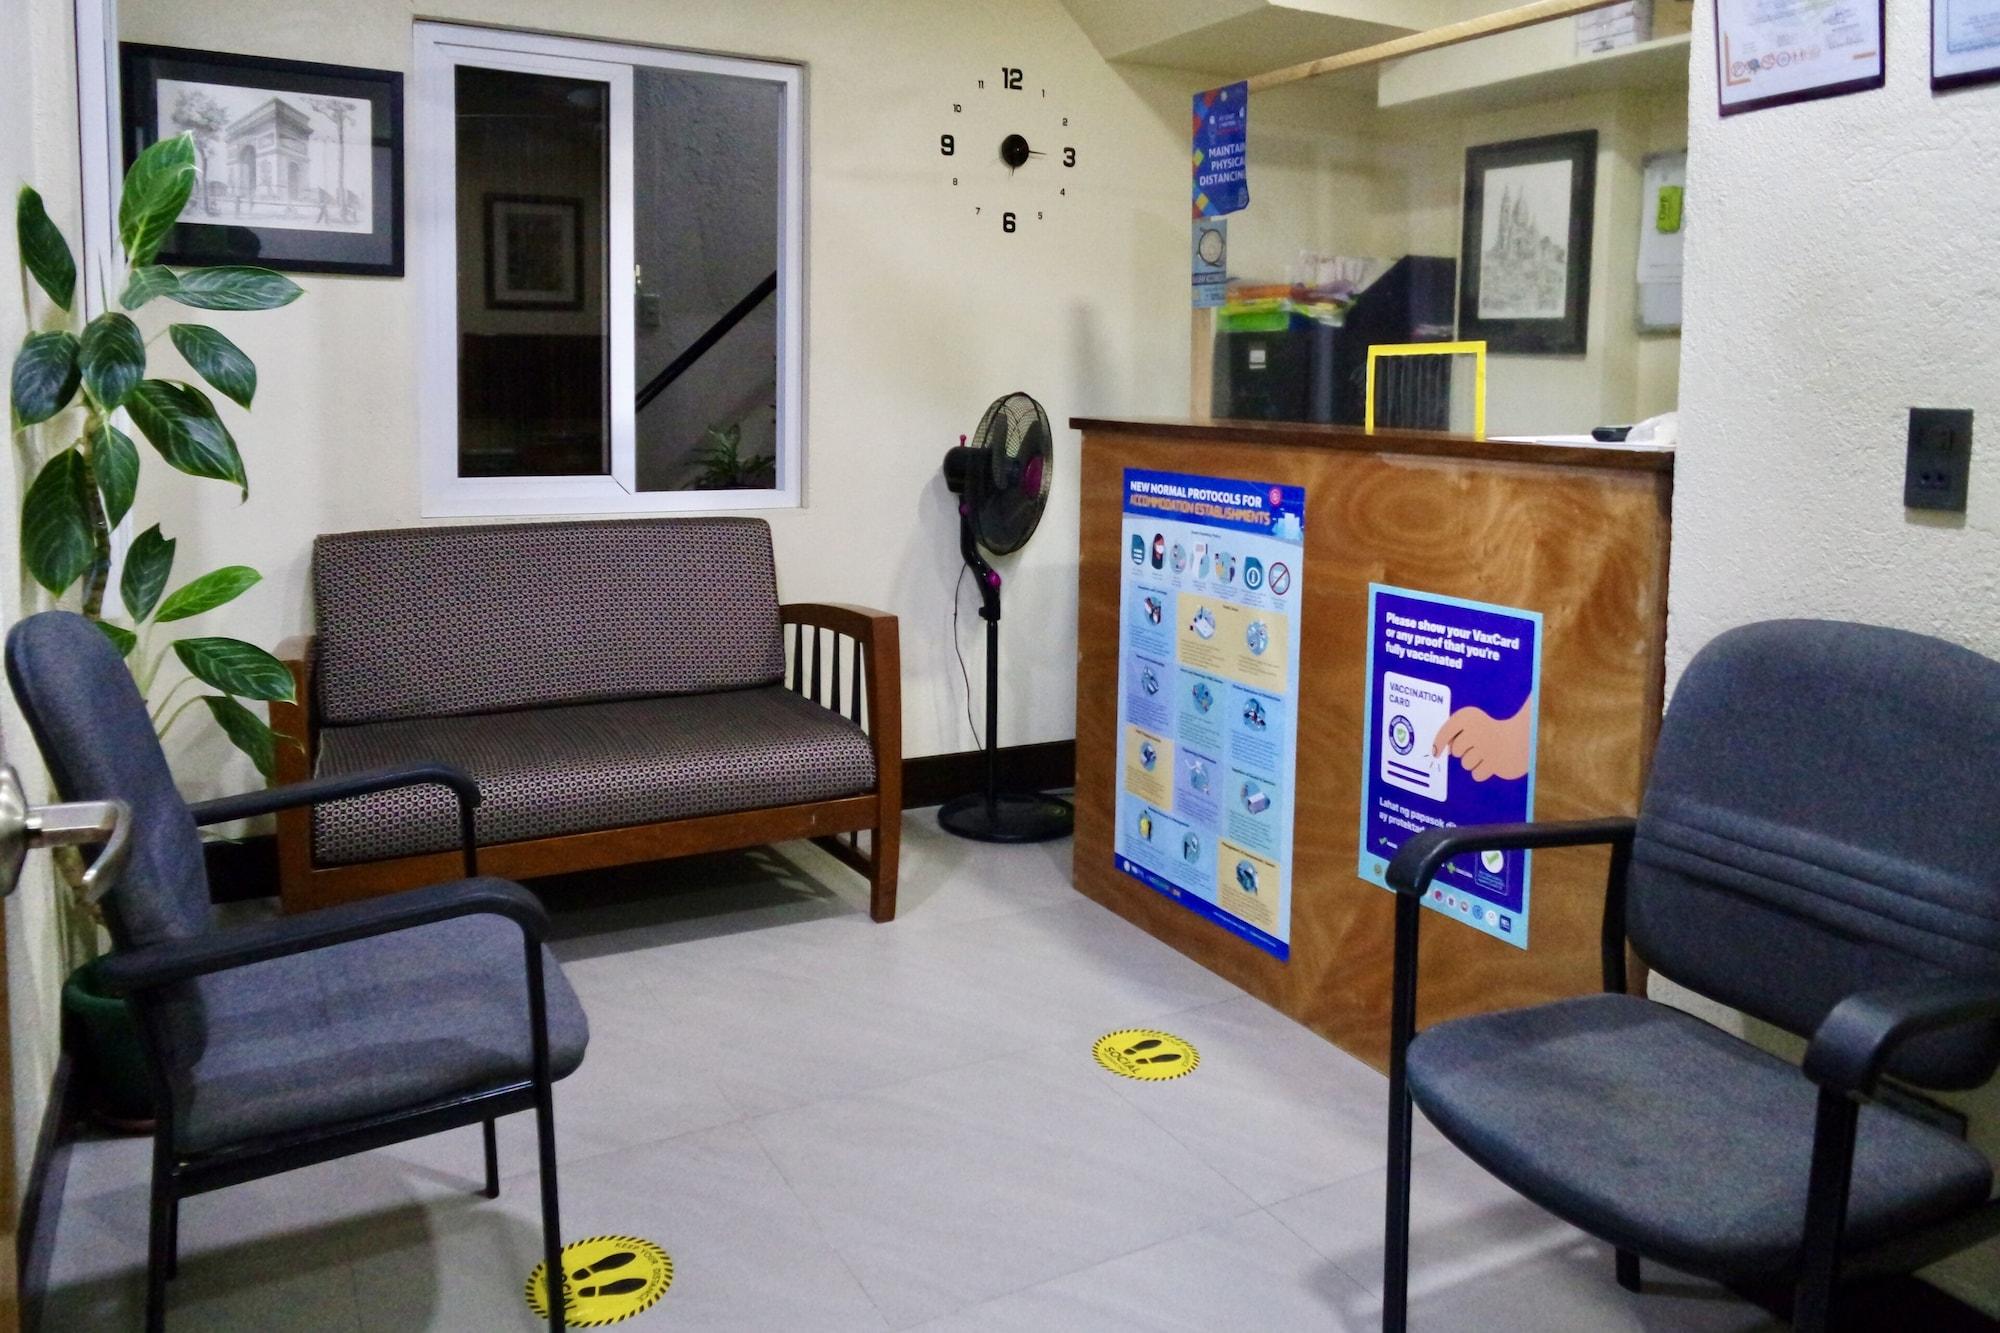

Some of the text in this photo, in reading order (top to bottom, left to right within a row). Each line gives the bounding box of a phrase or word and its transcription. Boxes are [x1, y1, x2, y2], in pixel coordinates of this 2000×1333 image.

[978, 80, 984, 89] 11
[1002, 67, 1023, 90] 12
[953, 104, 962, 113] 10
[1062, 117, 1068, 127] 2
[940, 134, 954, 156] 9
[1208, 142, 1245, 157] MAINTAI
[1063, 147, 1076, 167] 3
[1211, 156, 1245, 171] PHYSICA
[952, 178, 958, 186] 8
[1199, 170, 1245, 186] DISTANCIN
[1060, 188, 1066, 196] 4
[976, 207, 981, 215] 7
[1038, 212, 1043, 220] 5
[1003, 212, 1016, 233] 6
[1130, 481, 1262, 508] NEW NORMAL PROTOCOLS FOR
[1195, 502, 1271, 526] ESTABLISHMENTS
[1386, 612, 1520, 650] Please show your VaxCard
[1385, 628, 1500, 661] or any proof that you're
[1385, 641, 1463, 670] fully vaccinated
[1389, 682, 1444, 704] VACCINATION
[1389, 695, 1411, 708] CARD
[1379, 796, 1445, 828] Lahat ng papasok
[1103, 1046, 1140, 1074] SOCIAL
